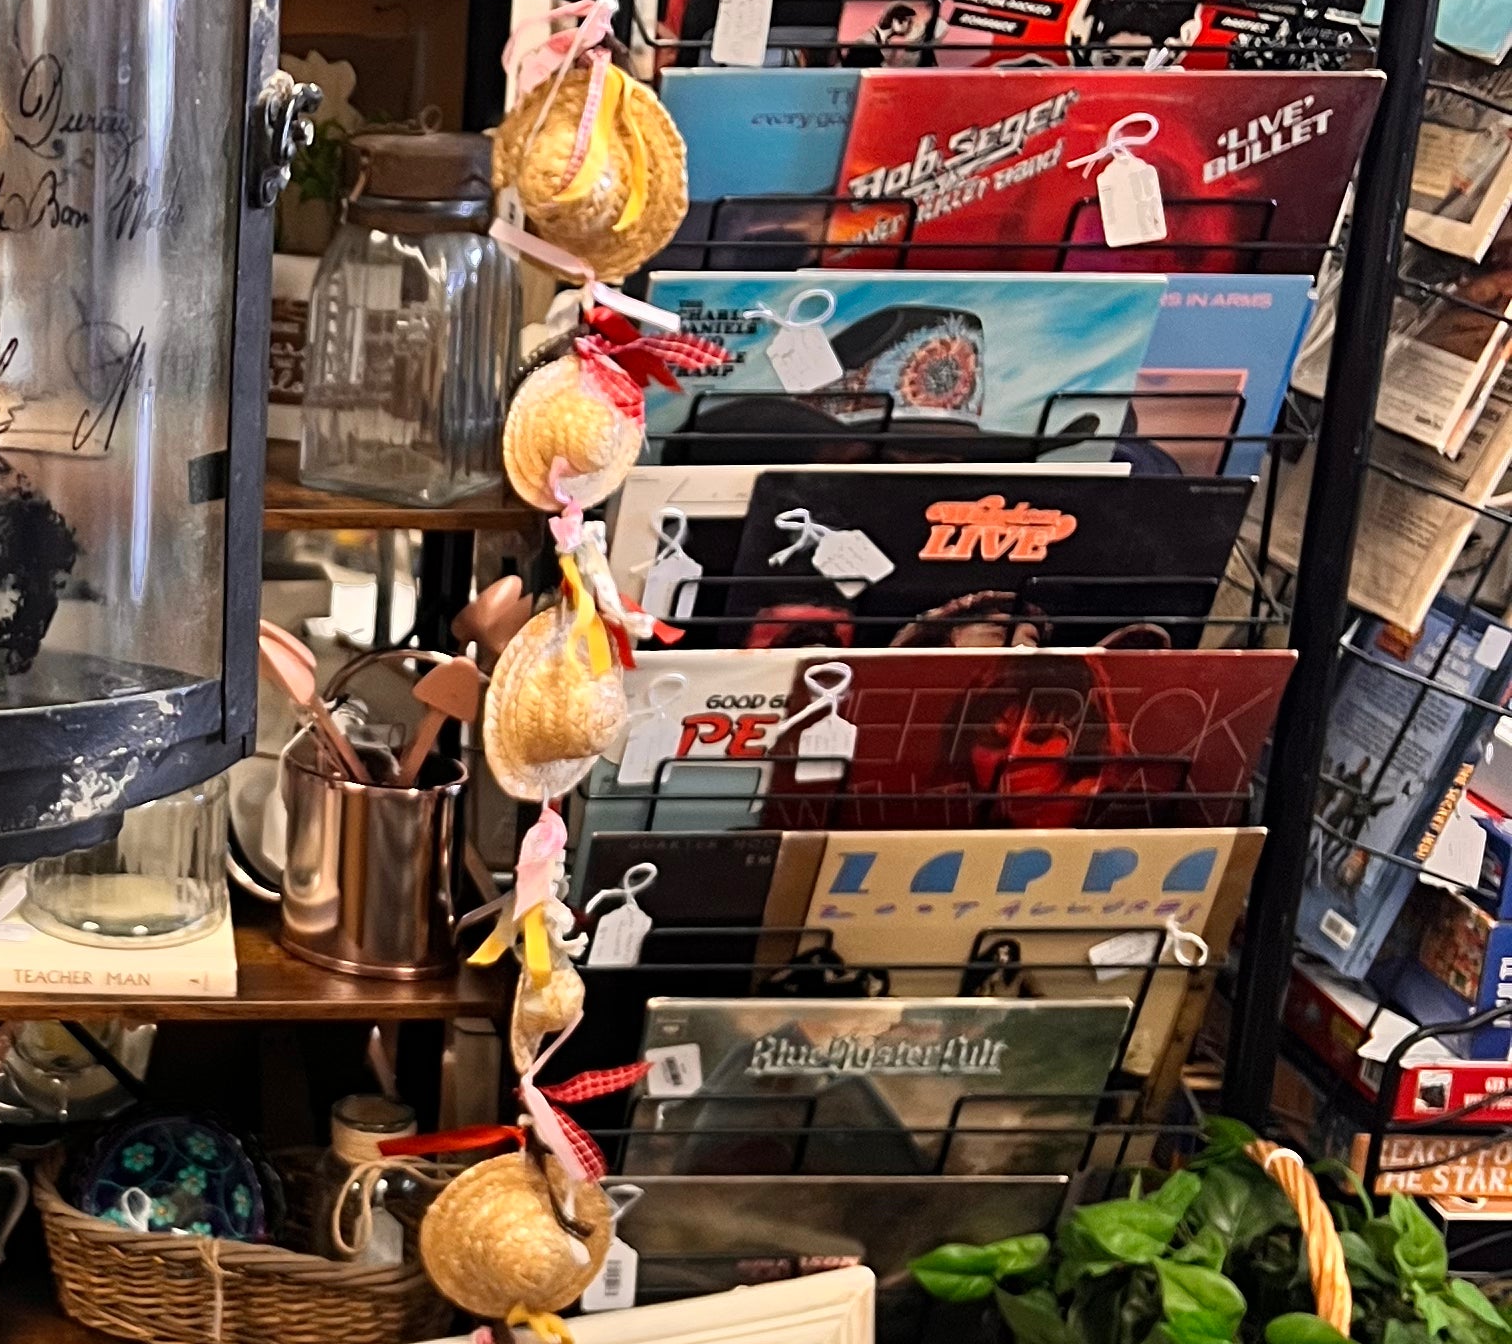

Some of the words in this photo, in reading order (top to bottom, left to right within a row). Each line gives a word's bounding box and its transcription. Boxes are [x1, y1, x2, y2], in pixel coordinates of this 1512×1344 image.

[1202, 109, 1334, 185] BULLET
[13, 969, 93, 986] TEACHER
[106, 971, 151, 987] MAN
